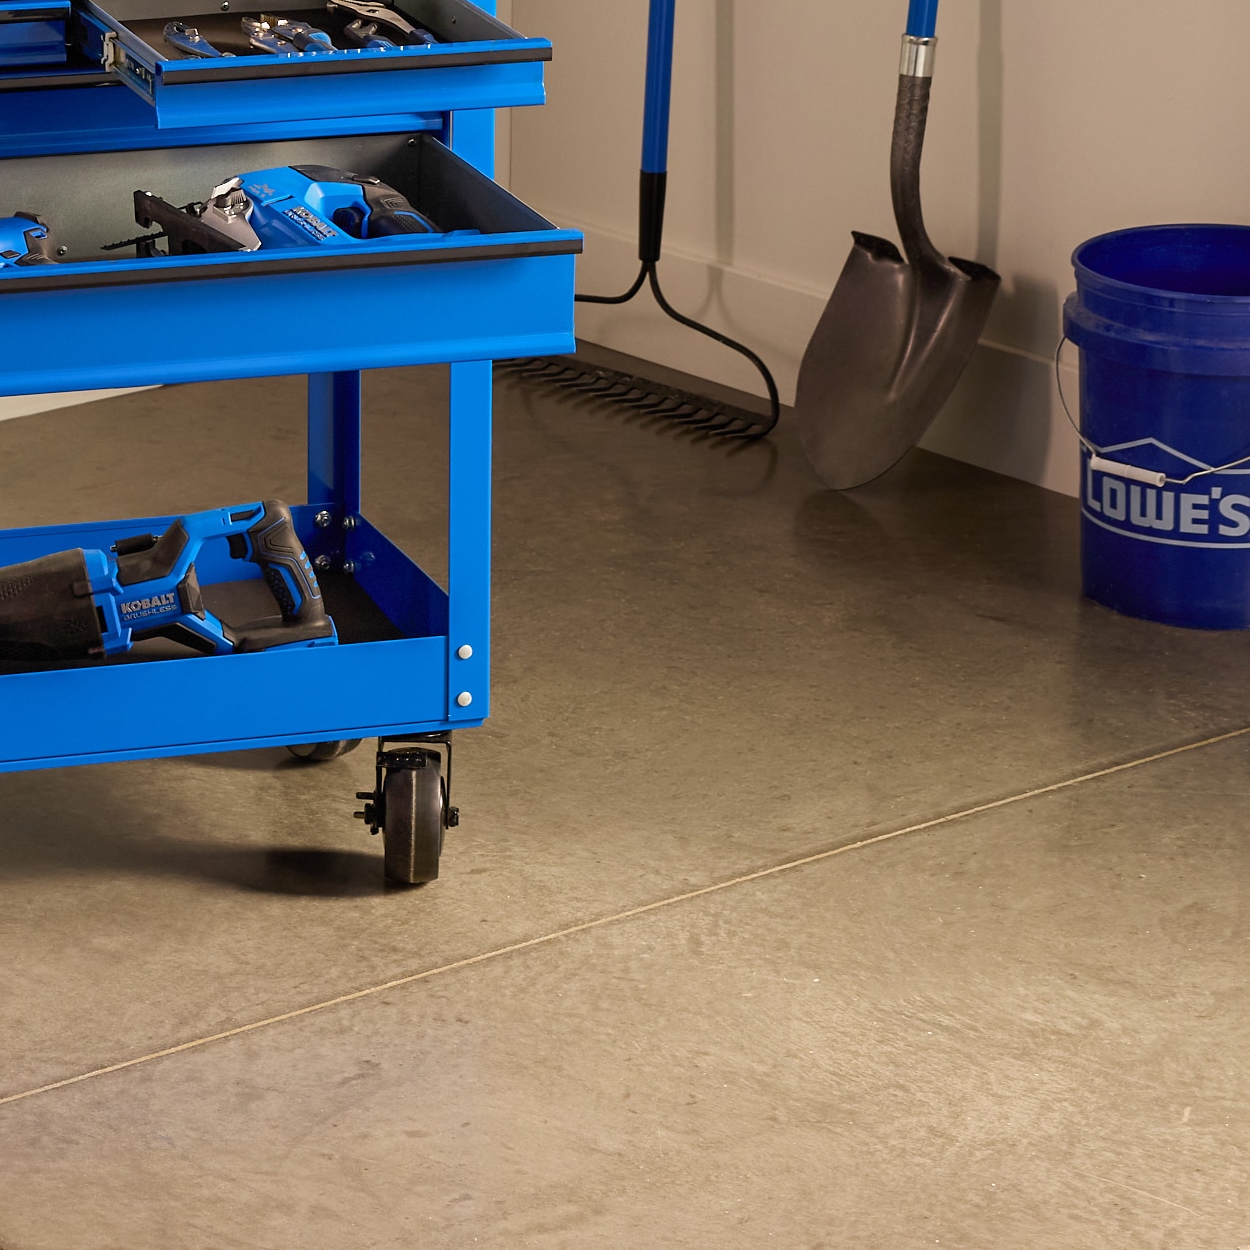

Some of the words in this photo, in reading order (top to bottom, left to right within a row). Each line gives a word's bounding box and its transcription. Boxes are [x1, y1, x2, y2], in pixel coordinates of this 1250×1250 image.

[291, 205, 339, 237] KOBALT
[1087, 457, 1250, 537] LOWE'S
[120, 592, 175, 614] KOBALT
[123, 604, 178, 621] BRUSHLESS
